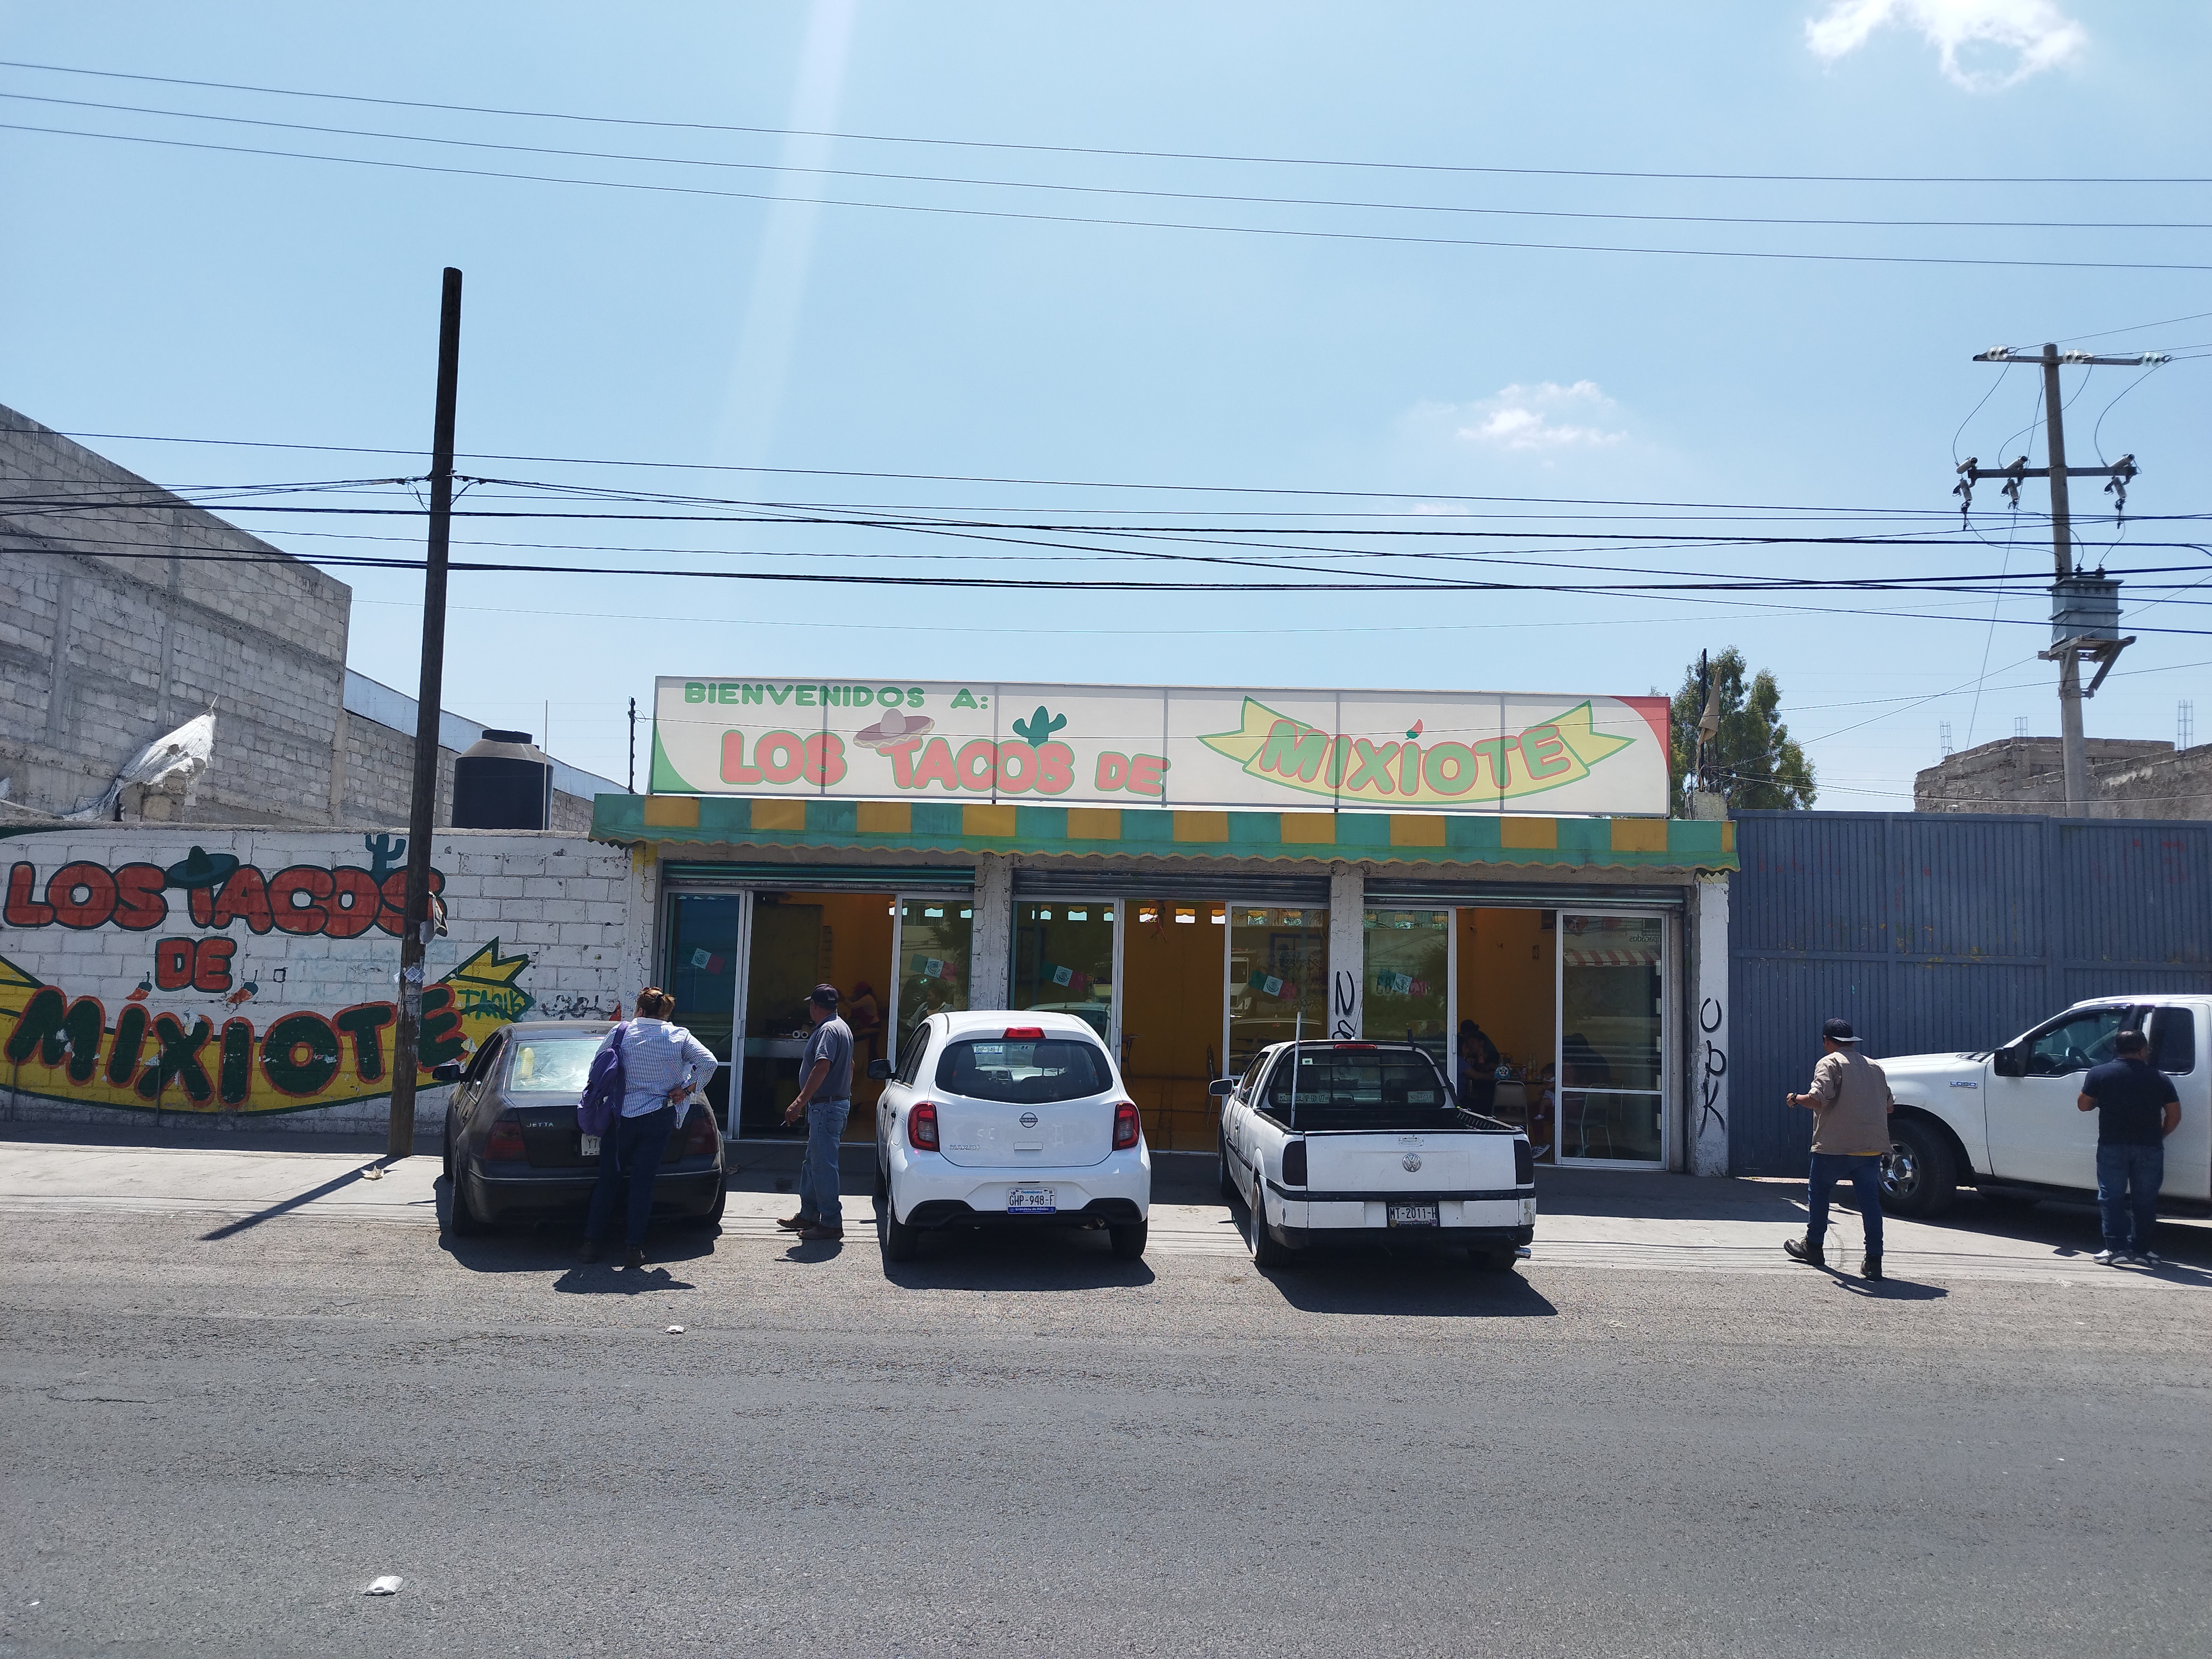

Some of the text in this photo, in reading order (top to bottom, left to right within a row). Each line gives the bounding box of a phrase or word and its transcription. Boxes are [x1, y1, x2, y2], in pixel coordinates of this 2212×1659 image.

[684, 682, 989, 710] BIENVENIDOS A:
[719, 718, 1572, 797] LOS TACOS DE MIXIOTE
[3, 860, 168, 930] LOS
[155, 936, 237, 993] DE
[1009, 1195, 1055, 1206] GHP-948-F
